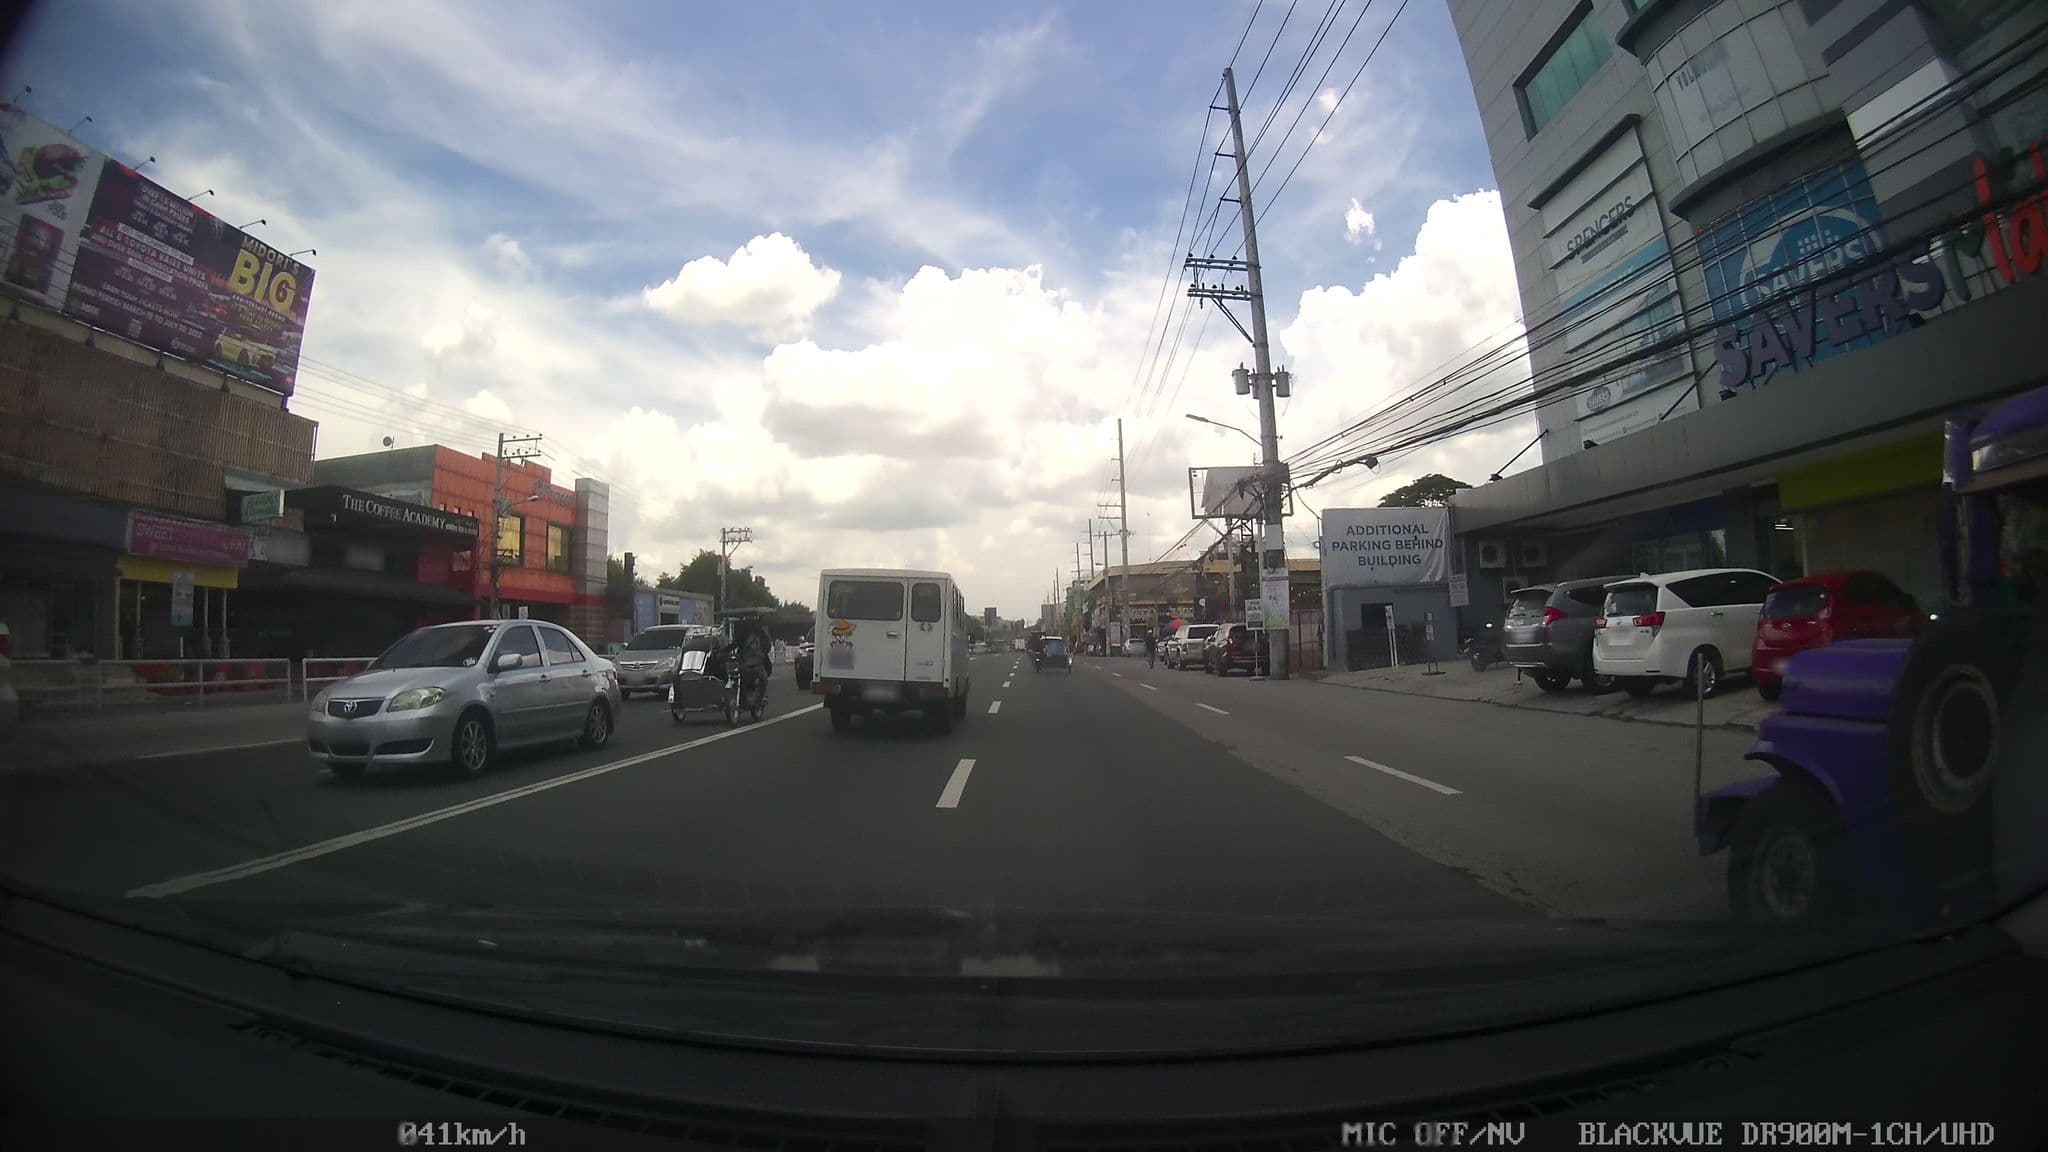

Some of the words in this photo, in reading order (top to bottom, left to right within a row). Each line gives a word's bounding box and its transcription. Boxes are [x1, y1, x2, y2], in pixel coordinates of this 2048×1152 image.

[122, 235, 156, 257] TOYOTA
[182, 263, 206, 281] UNITS
[242, 235, 299, 276] MIDORI'S
[230, 248, 297, 316] BIG
[1714, 250, 1946, 388] SAVERS
[342, 494, 365, 513] THE
[365, 499, 401, 519] COFFEE
[402, 508, 447, 530] ACADEMY
[1346, 523, 1429, 536] ADDITIONAL
[136, 521, 176, 540] SWEET
[1331, 539, 1391, 552] PARKING
[1395, 537, 1443, 551] BEHIND
[1358, 554, 1421, 567] BUILDING
